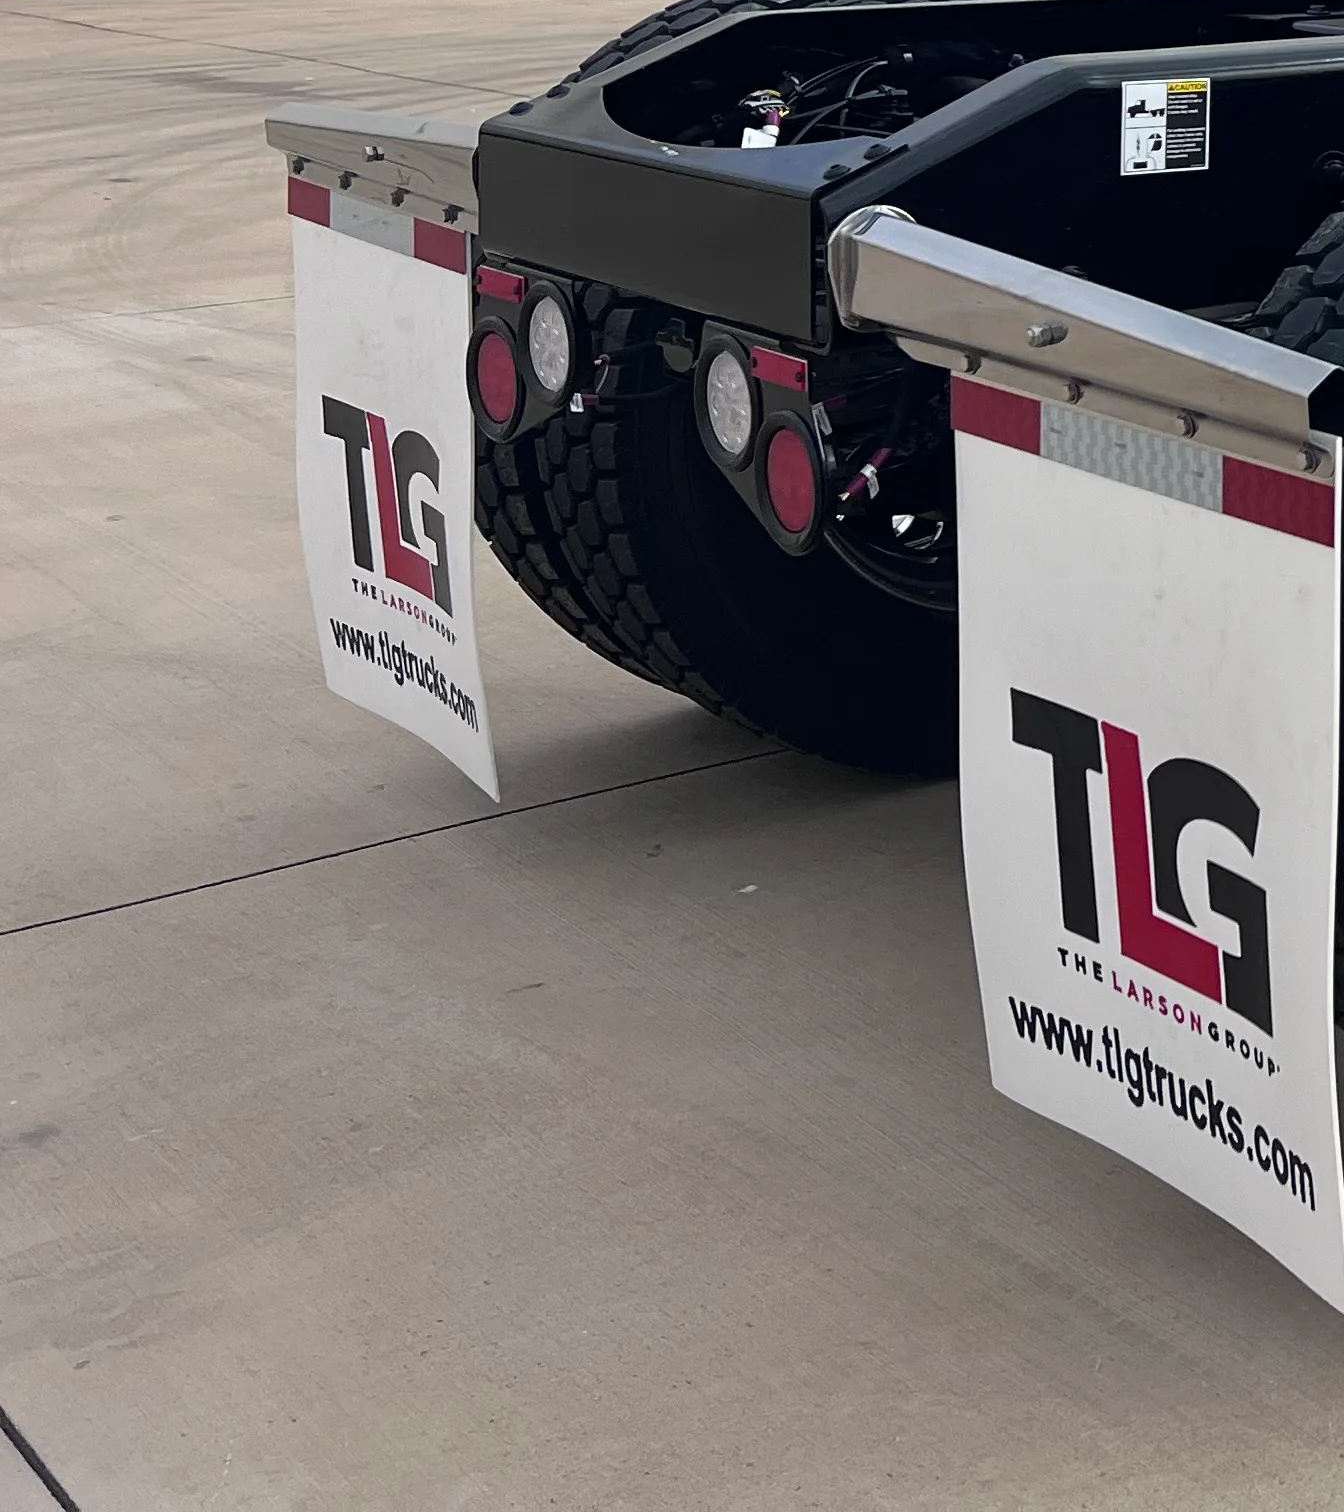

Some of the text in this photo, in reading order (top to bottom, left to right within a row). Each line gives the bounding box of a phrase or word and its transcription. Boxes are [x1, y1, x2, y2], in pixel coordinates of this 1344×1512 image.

[322, 394, 454, 619] TLG
[330, 618, 479, 733] www.tlgtrucks.com
[352, 578, 378, 600] THE
[380, 589, 428, 625] LARSON
[1010, 687, 1274, 1039] TLG
[1057, 946, 1276, 1077] THE LARSON GROUP
[1008, 995, 1316, 1212] www.tlgtrucks.com
